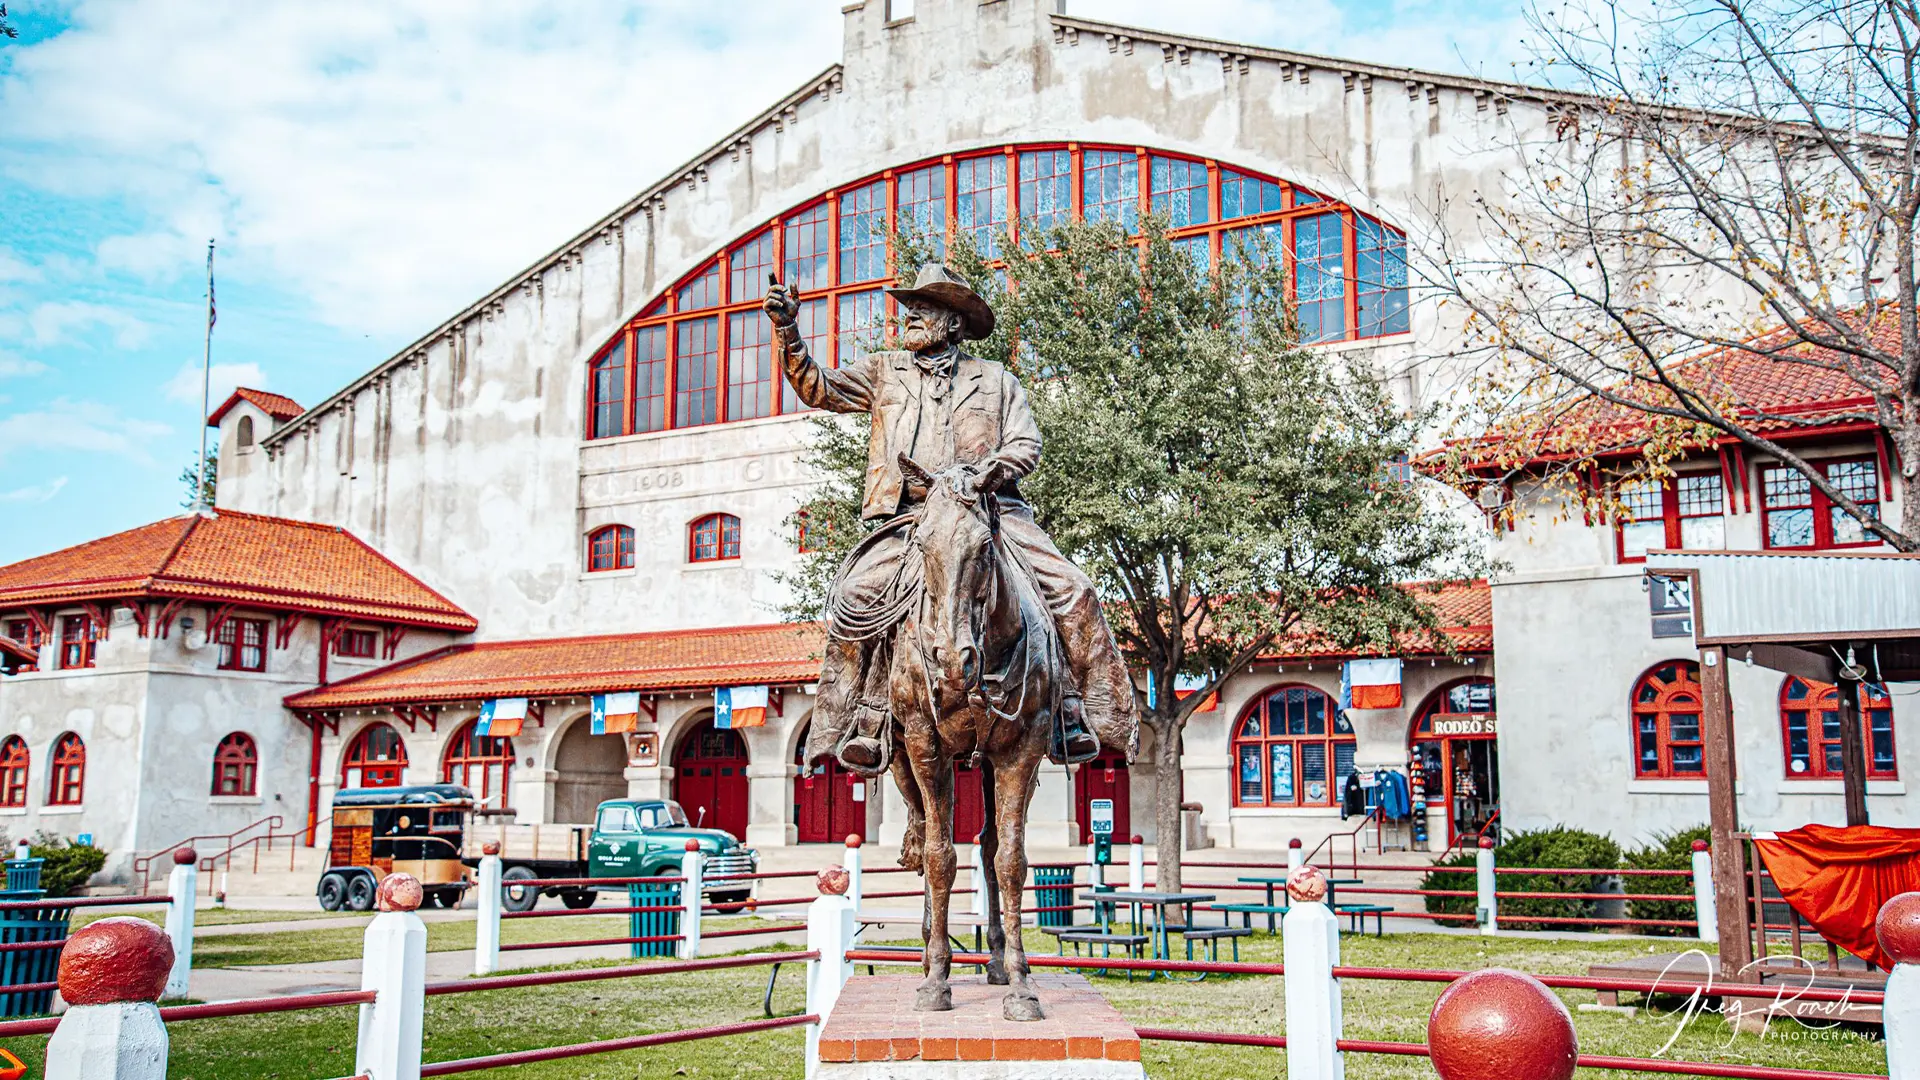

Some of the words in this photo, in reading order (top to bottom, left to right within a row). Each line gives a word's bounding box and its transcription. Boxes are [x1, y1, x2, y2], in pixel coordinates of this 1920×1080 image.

[633, 471, 684, 492] 1908
[1434, 720, 1482, 735] RODEO
[1485, 720, 1497, 733] S
